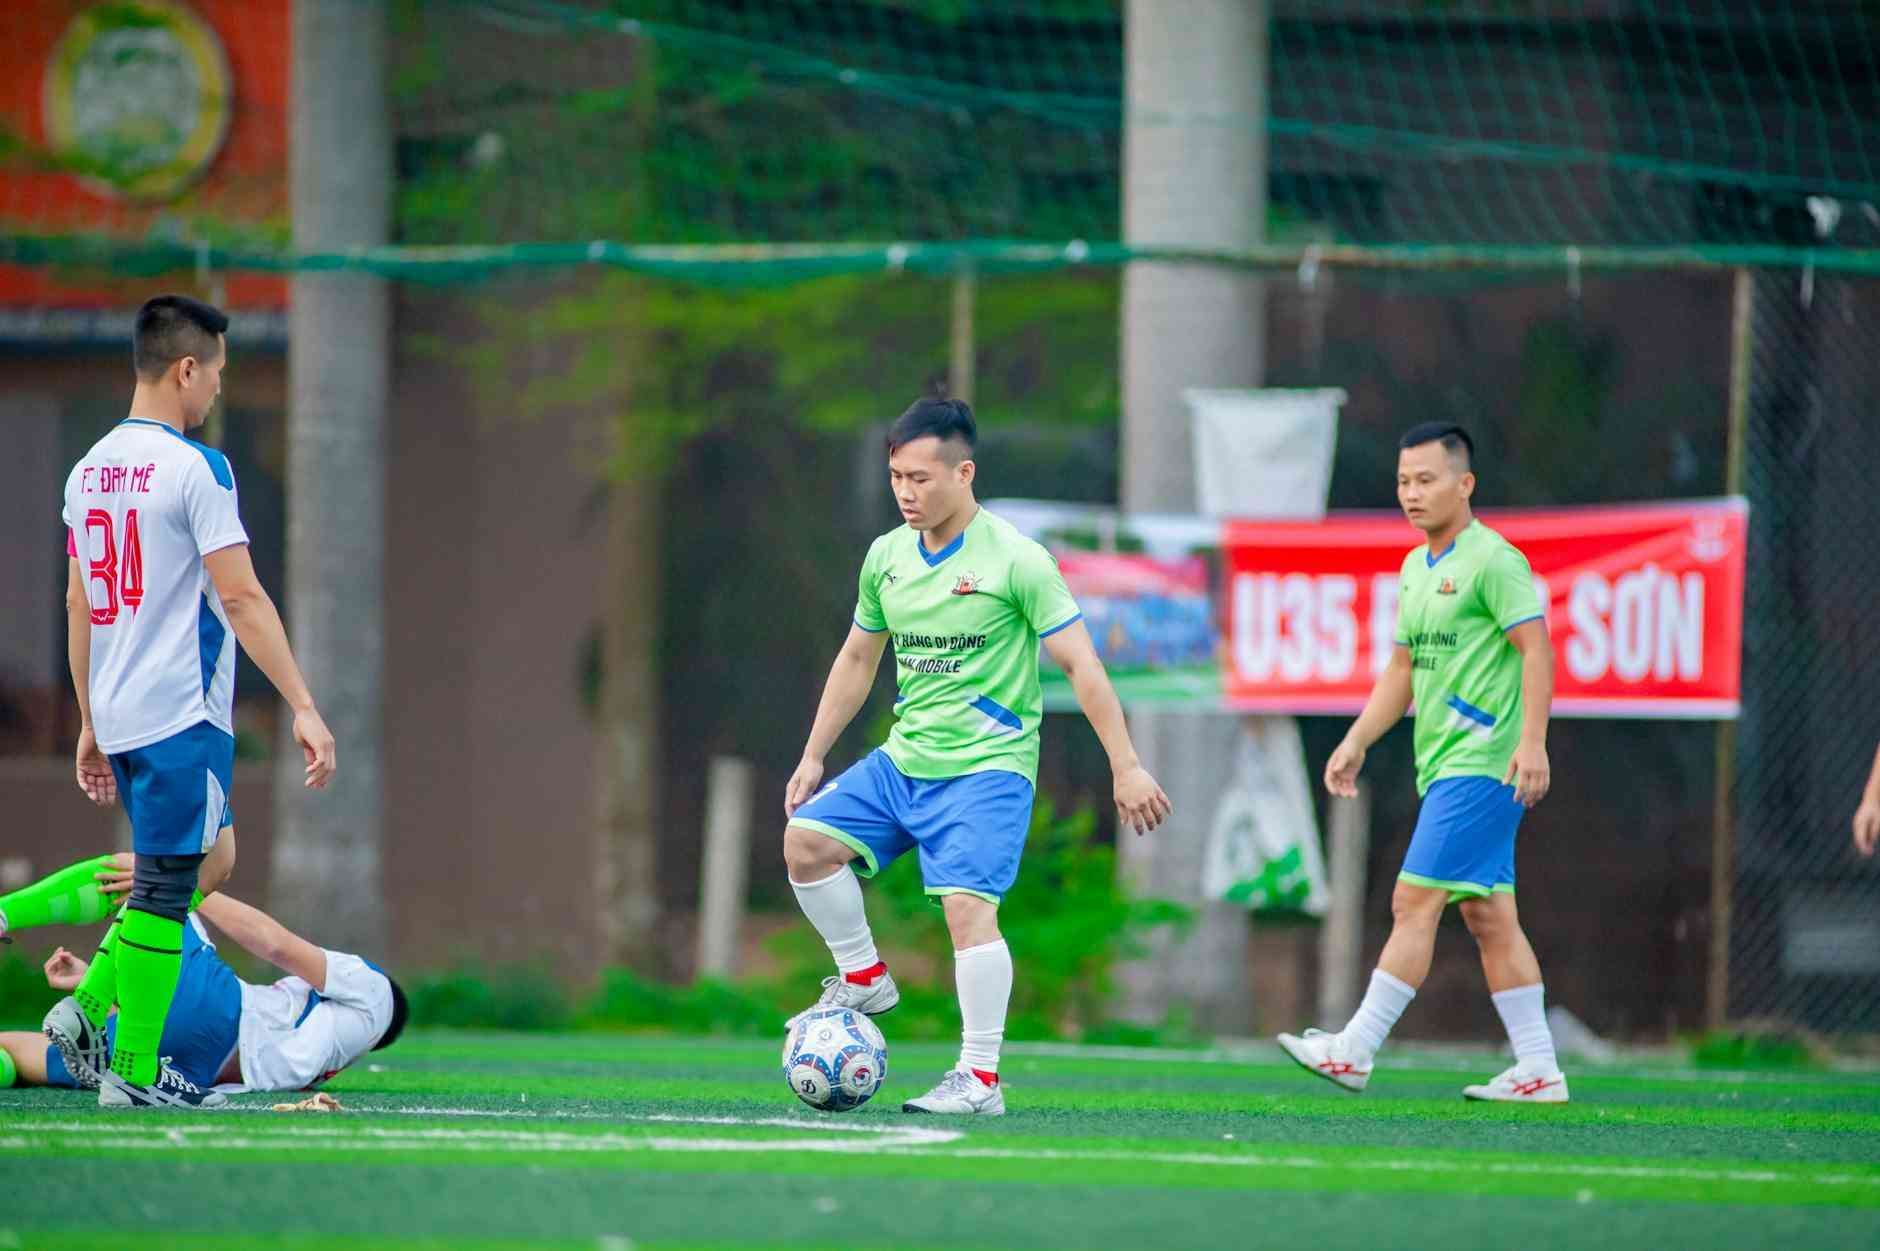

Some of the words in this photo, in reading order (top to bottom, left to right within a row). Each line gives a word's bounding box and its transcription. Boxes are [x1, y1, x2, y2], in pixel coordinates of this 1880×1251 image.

[1234, 571, 1358, 684] U35
[1566, 561, 1704, 684] SƠN
[915, 658, 962, 674] MOBILE
